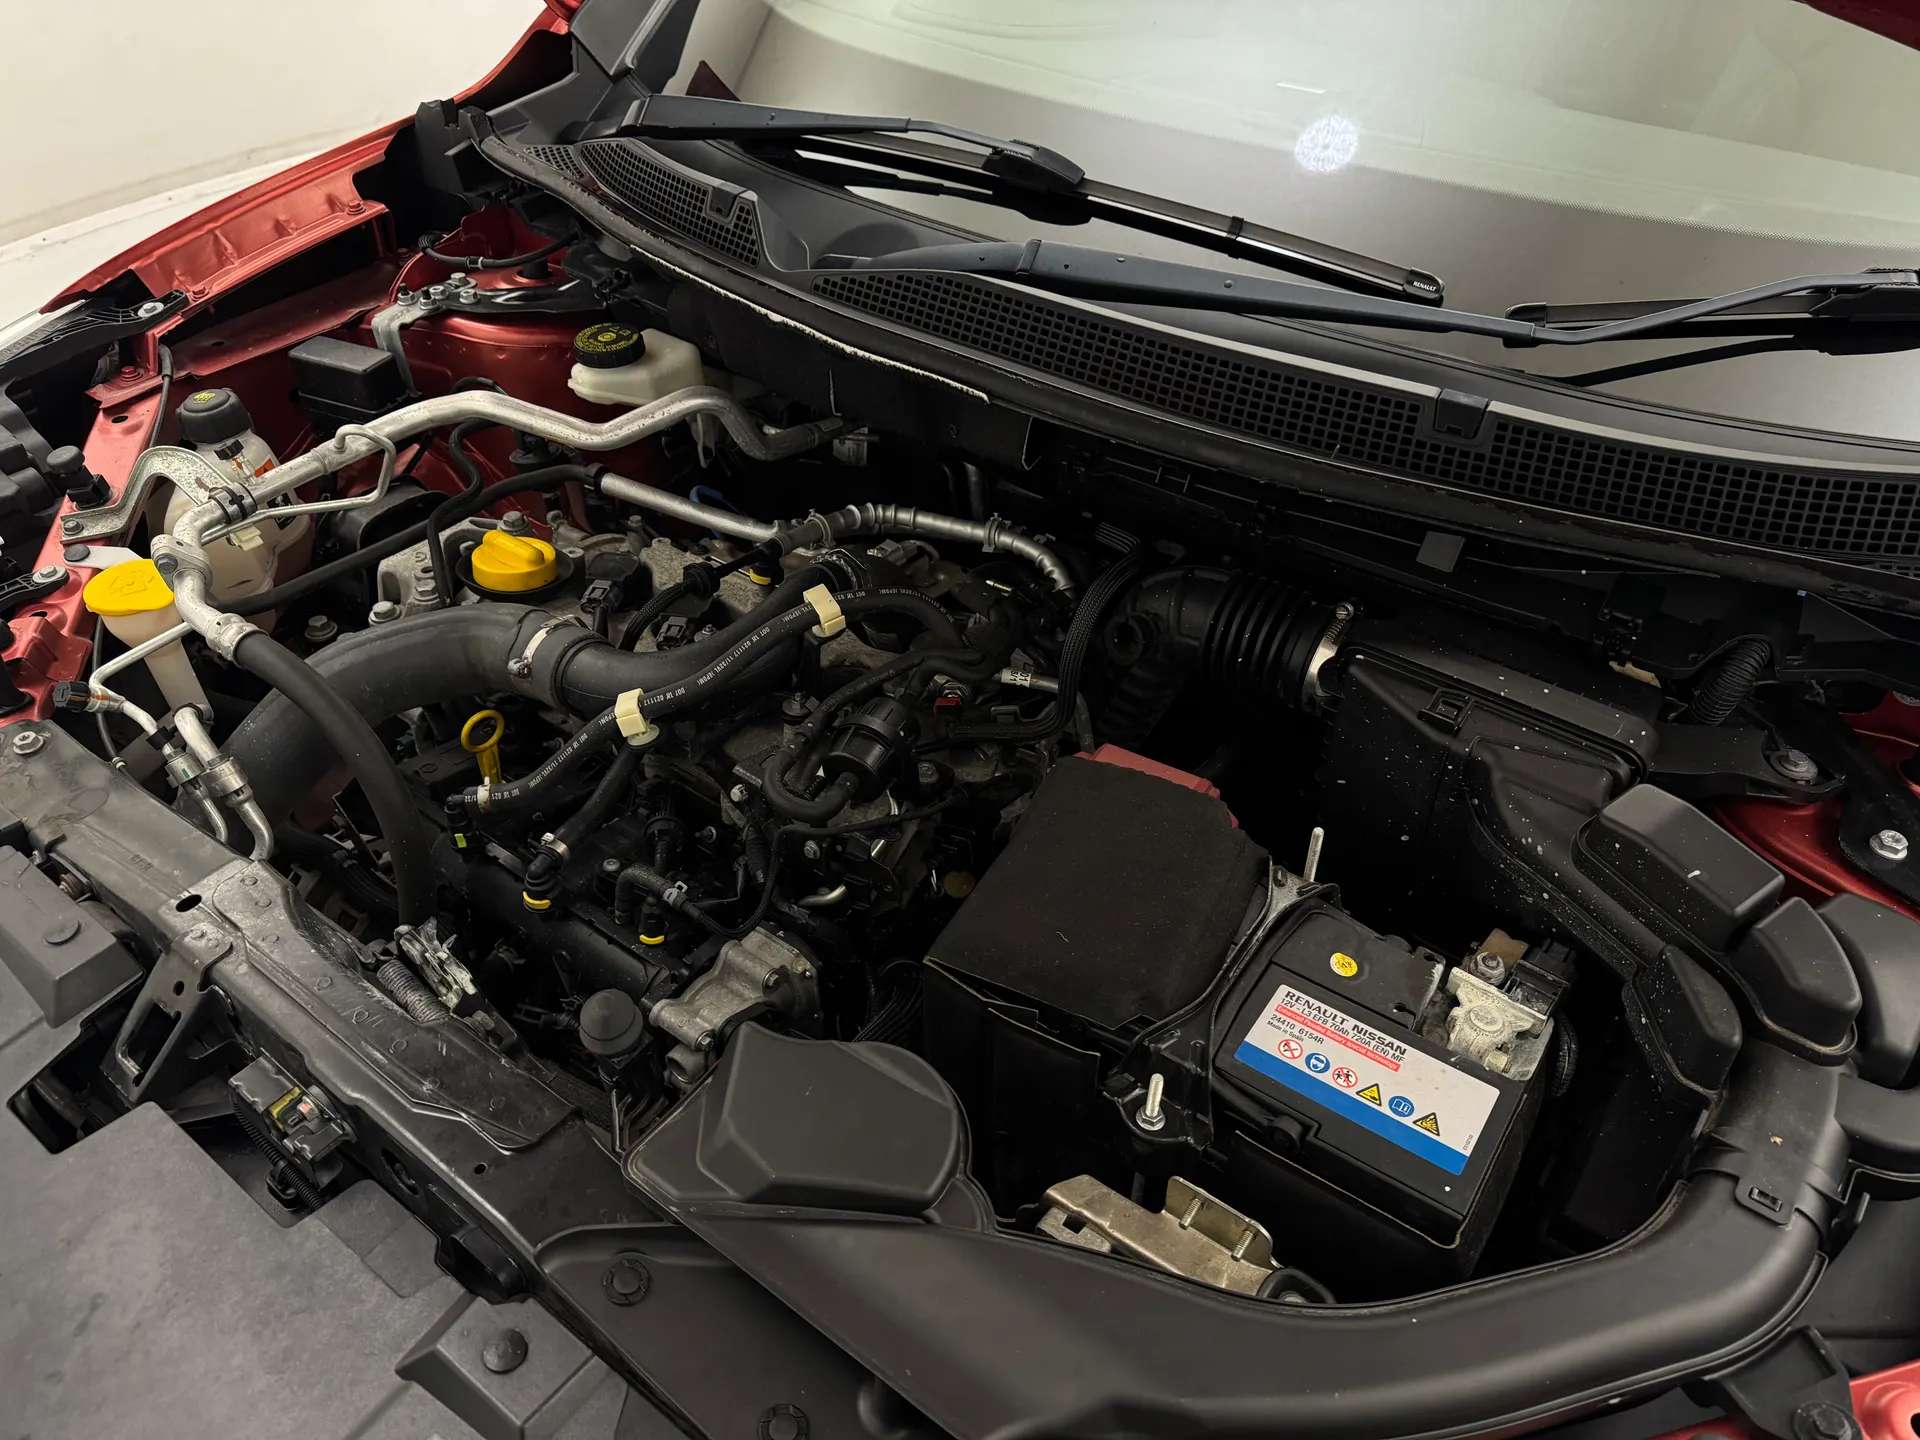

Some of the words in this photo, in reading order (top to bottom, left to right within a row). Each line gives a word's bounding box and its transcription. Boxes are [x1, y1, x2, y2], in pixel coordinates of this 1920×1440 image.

[1412, 280, 1437, 292] RENAULT
[1266, 1020, 1282, 1030] Made
[1287, 1030, 1304, 1042] Spain
[1270, 1013, 1295, 1030] 24410
[1280, 997, 1295, 1009] 12V
[1300, 1007, 1312, 1017] L3
[1312, 1013, 1328, 1025] EFB
[1328, 1021, 1350, 1036] 70Ah
[1350, 1032, 1371, 1047] 720A
[1371, 1043, 1390, 1057] (EN)
[1285, 990, 1348, 1026] RENAULT
[1351, 1024, 1407, 1056] NISSAN
